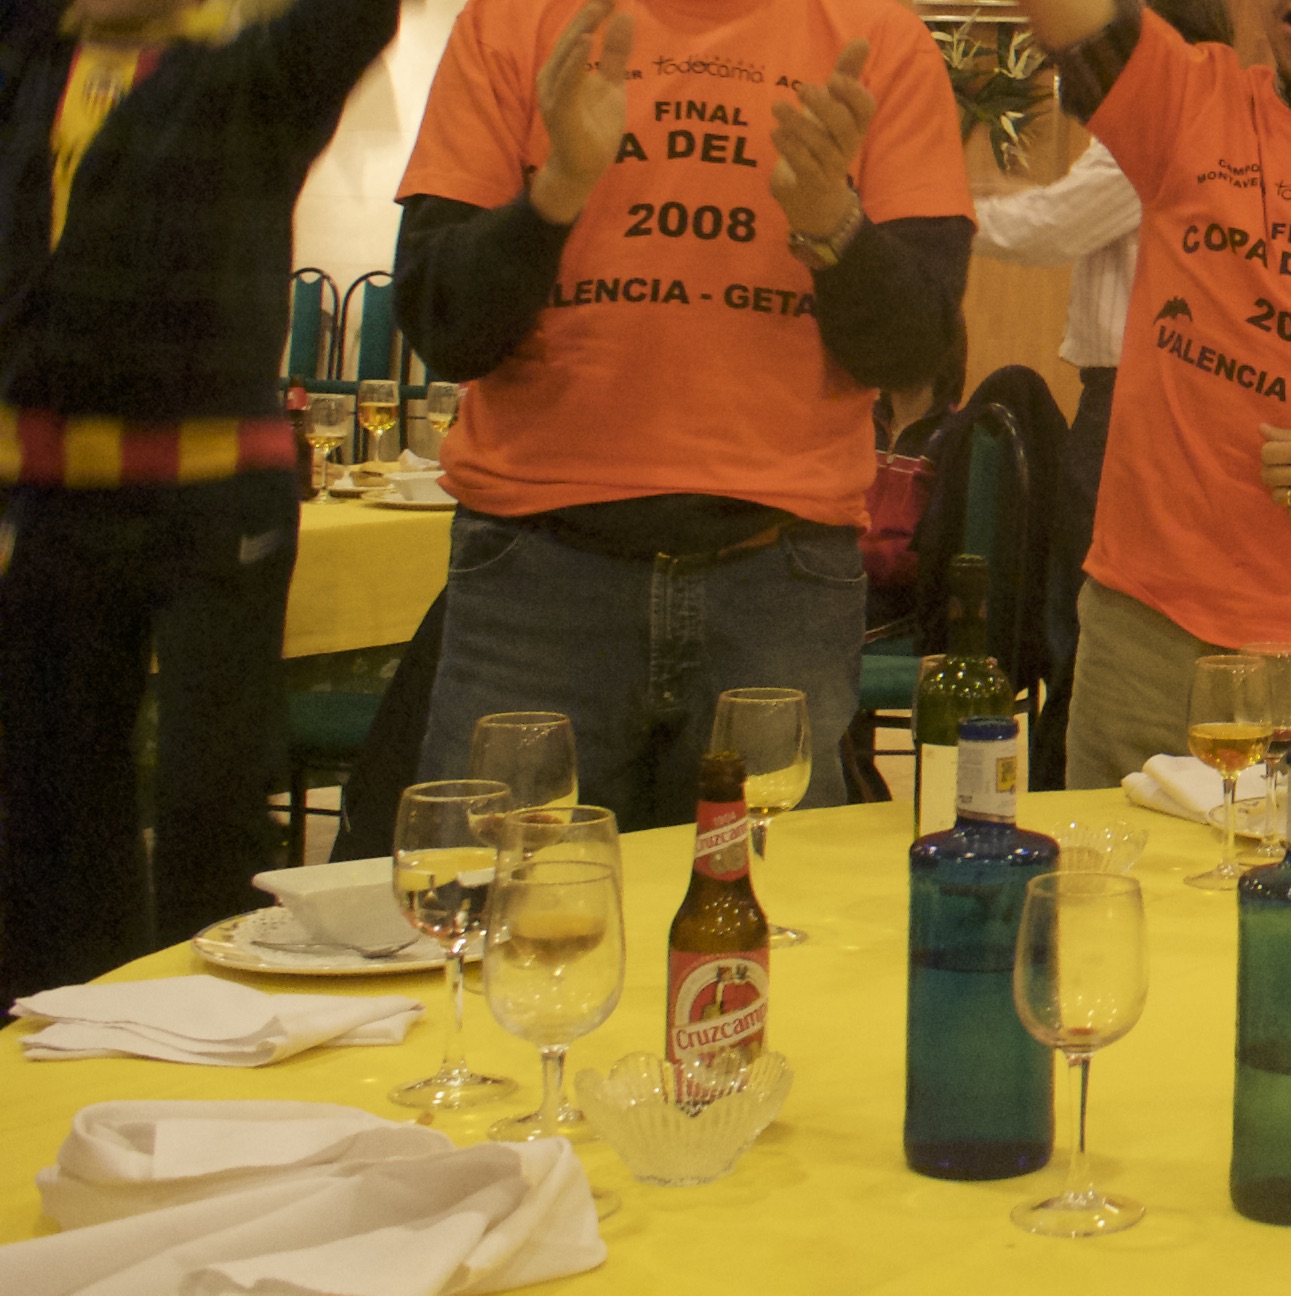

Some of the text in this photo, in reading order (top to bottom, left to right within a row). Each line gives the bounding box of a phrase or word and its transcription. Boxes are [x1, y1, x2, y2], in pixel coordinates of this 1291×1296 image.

[654, 100, 748, 127] FINAL
[667, 130, 758, 168] DEL
[624, 202, 756, 243] 2008
[1183, 223, 1269, 269] COPA
[553, 277, 690, 308] LENCIA
[723, 284, 814, 318] GETA
[1155, 324, 1287, 403] VALENCIA
[676, 1003, 767, 1050] Cruzcam
